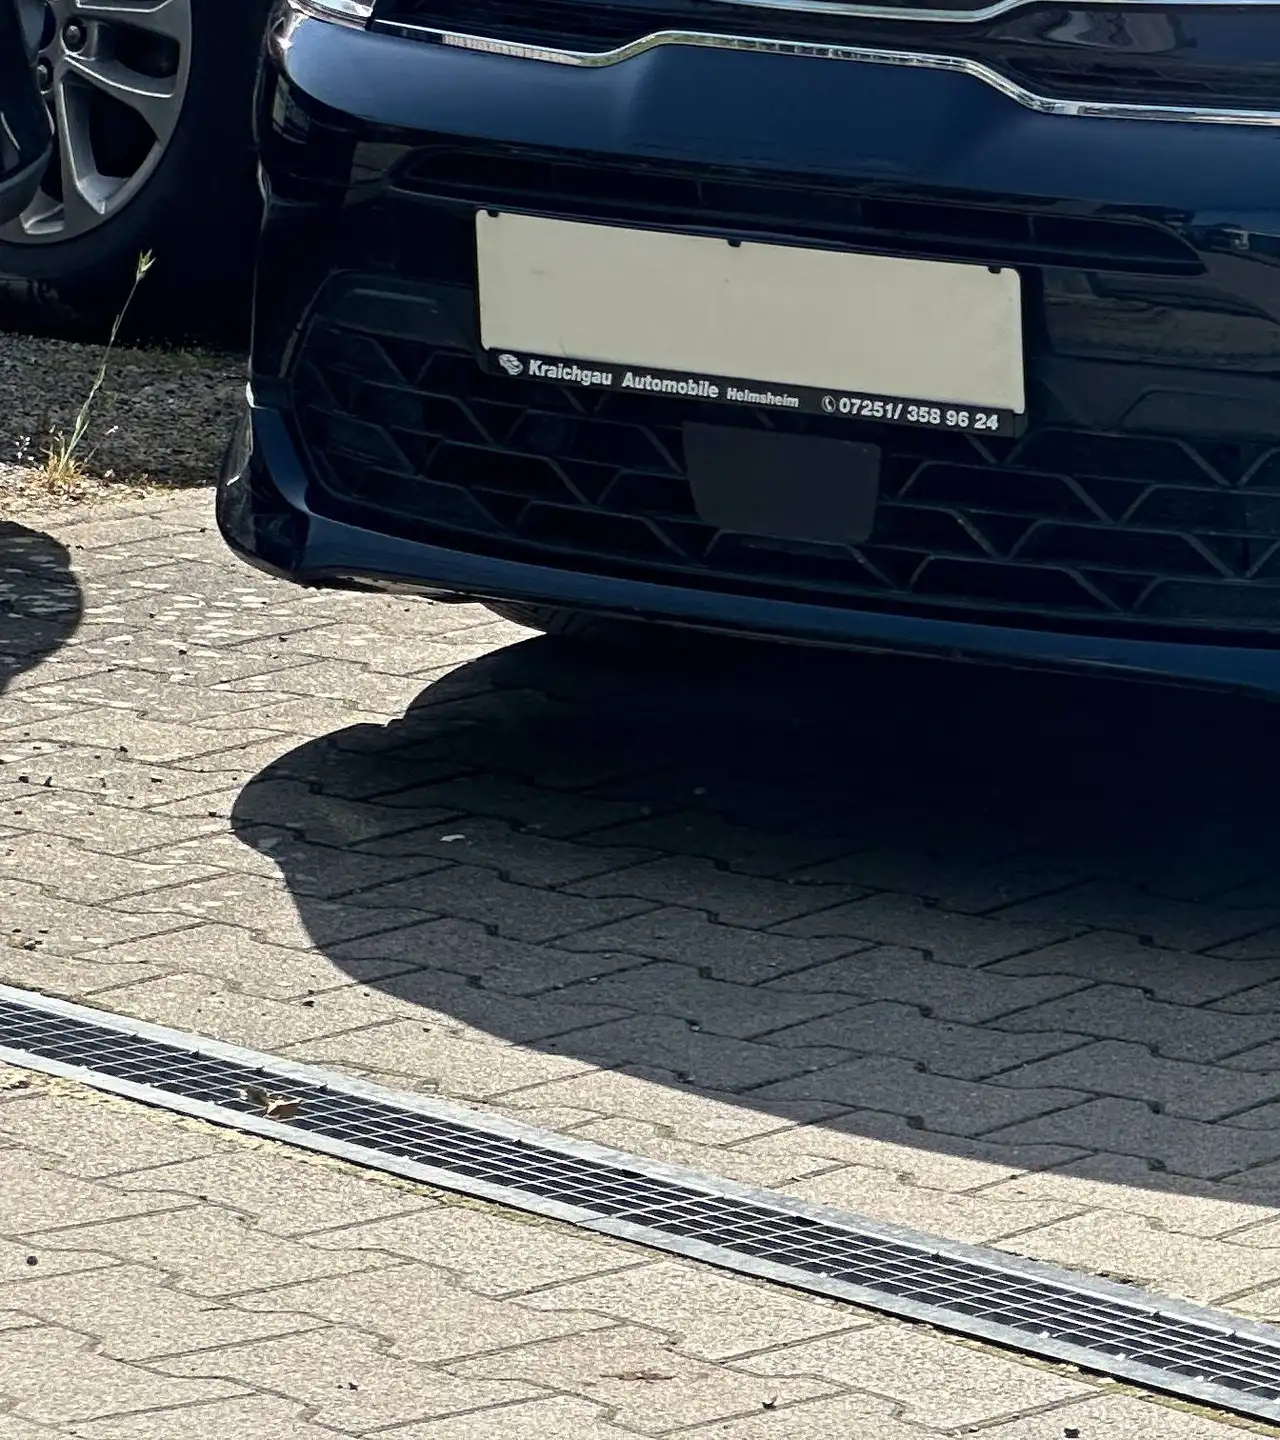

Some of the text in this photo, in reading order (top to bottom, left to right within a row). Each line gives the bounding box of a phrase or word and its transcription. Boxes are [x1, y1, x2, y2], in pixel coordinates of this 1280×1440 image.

[528, 359, 613, 387] Kraichgau
[621, 371, 719, 398] Automobile
[839, 397, 903, 420] 07251/
[907, 406, 941, 424] 358
[946, 409, 970, 427] 96
[974, 413, 999, 431] 24
